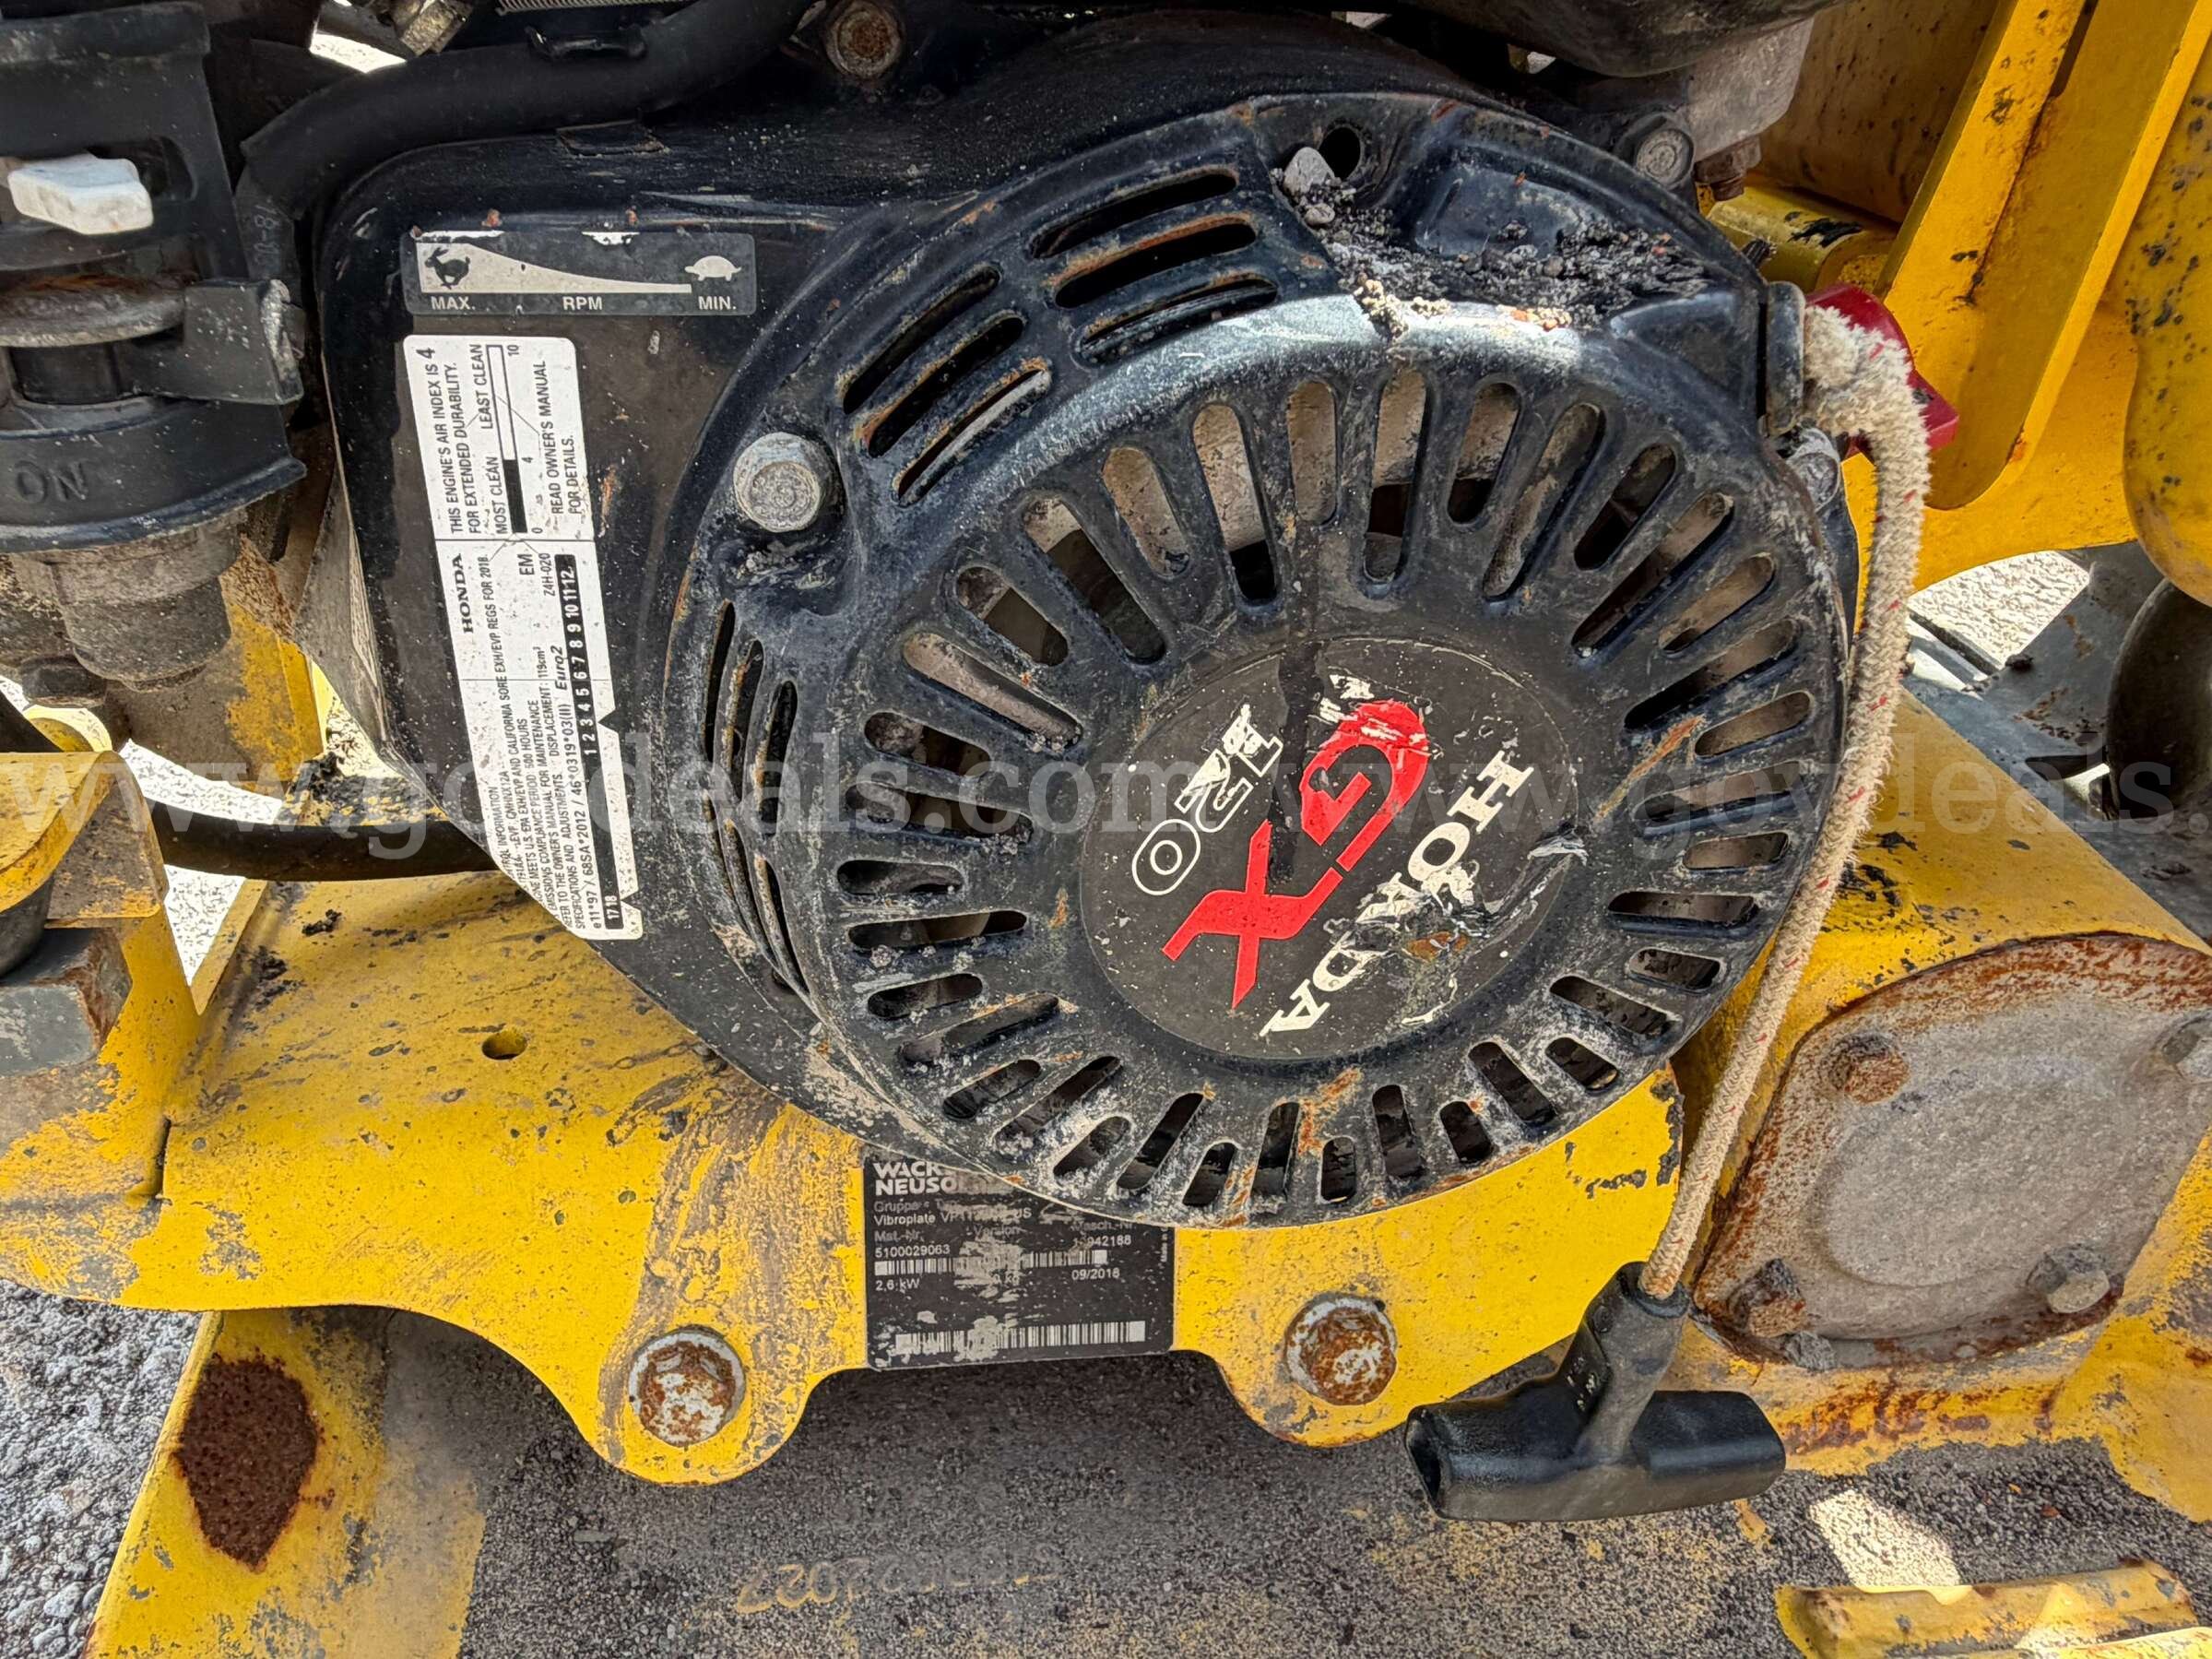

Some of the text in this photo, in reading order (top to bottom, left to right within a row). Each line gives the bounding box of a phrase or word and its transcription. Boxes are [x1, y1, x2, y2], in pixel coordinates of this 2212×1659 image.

[432, 296, 737, 311] MAX. RPM MIN.
[506, 344, 519, 356] 10
[469, 344, 492, 428] LEAST CLEAN
[416, 348, 462, 532] THIS ENGINE'S AIR INDEX IS 4
[444, 361, 481, 533] FOR EXTENDED DURABILITY.
[533, 361, 563, 514] READ OWNER'S MANUAL
[14, 460, 89, 503] ON
[560, 434, 583, 513] FOR DETAILS.
[485, 456, 507, 533] MOST CLEAN
[516, 554, 534, 575] EM
[538, 552, 555, 596] Z4H-020
[480, 581, 493, 599] FOR
[561, 570, 575, 587] 12
[451, 552, 473, 633] HONDA
[562, 589, 577, 600] 11
[484, 604, 498, 629] REGS
[564, 604, 579, 617] 10
[566, 623, 581, 632] 9
[489, 633, 505, 671] EXH/EVP
[549, 645, 568, 690] Euro2
[496, 676, 509, 700] SORE
[577, 703, 591, 711] 4
[501, 704, 518, 753] CALIFORNIA
[516, 718, 531, 750] HOURS
[527, 700, 547, 766] MAINTENANCE
[509, 757, 522, 776] AND
[522, 753, 534, 768] 500
[538, 769, 550, 787] FOR
[513, 779, 528, 813] EXH/EVP
[541, 789, 556, 827] MANUAL
[488, 787, 507, 846] INFORMATION
[519, 817, 531, 832] EPA
[531, 808, 550, 863] COMPLIANCE
[548, 832, 563, 869] OWNER'S
[562, 845, 574, 861] AND
[1162, 699, 1430, 1010] GX
[526, 852, 539, 878] MEETS
[540, 867, 557, 909] EMISSIONS
[554, 872, 566, 887] THE
[557, 890, 568, 901] TO
[566, 865, 586, 928] SPECIFICATIONS
[604, 895, 618, 906] 18
[606, 909, 620, 918] 17
[873, 1161, 944, 1179] WACK
[875, 1176, 959, 1196] NEUSO
[874, 1214, 936, 1226] Vibroplate
[875, 1245, 951, 1259] 5100029063
[1071, 1268, 1120, 1281] 09/2018
